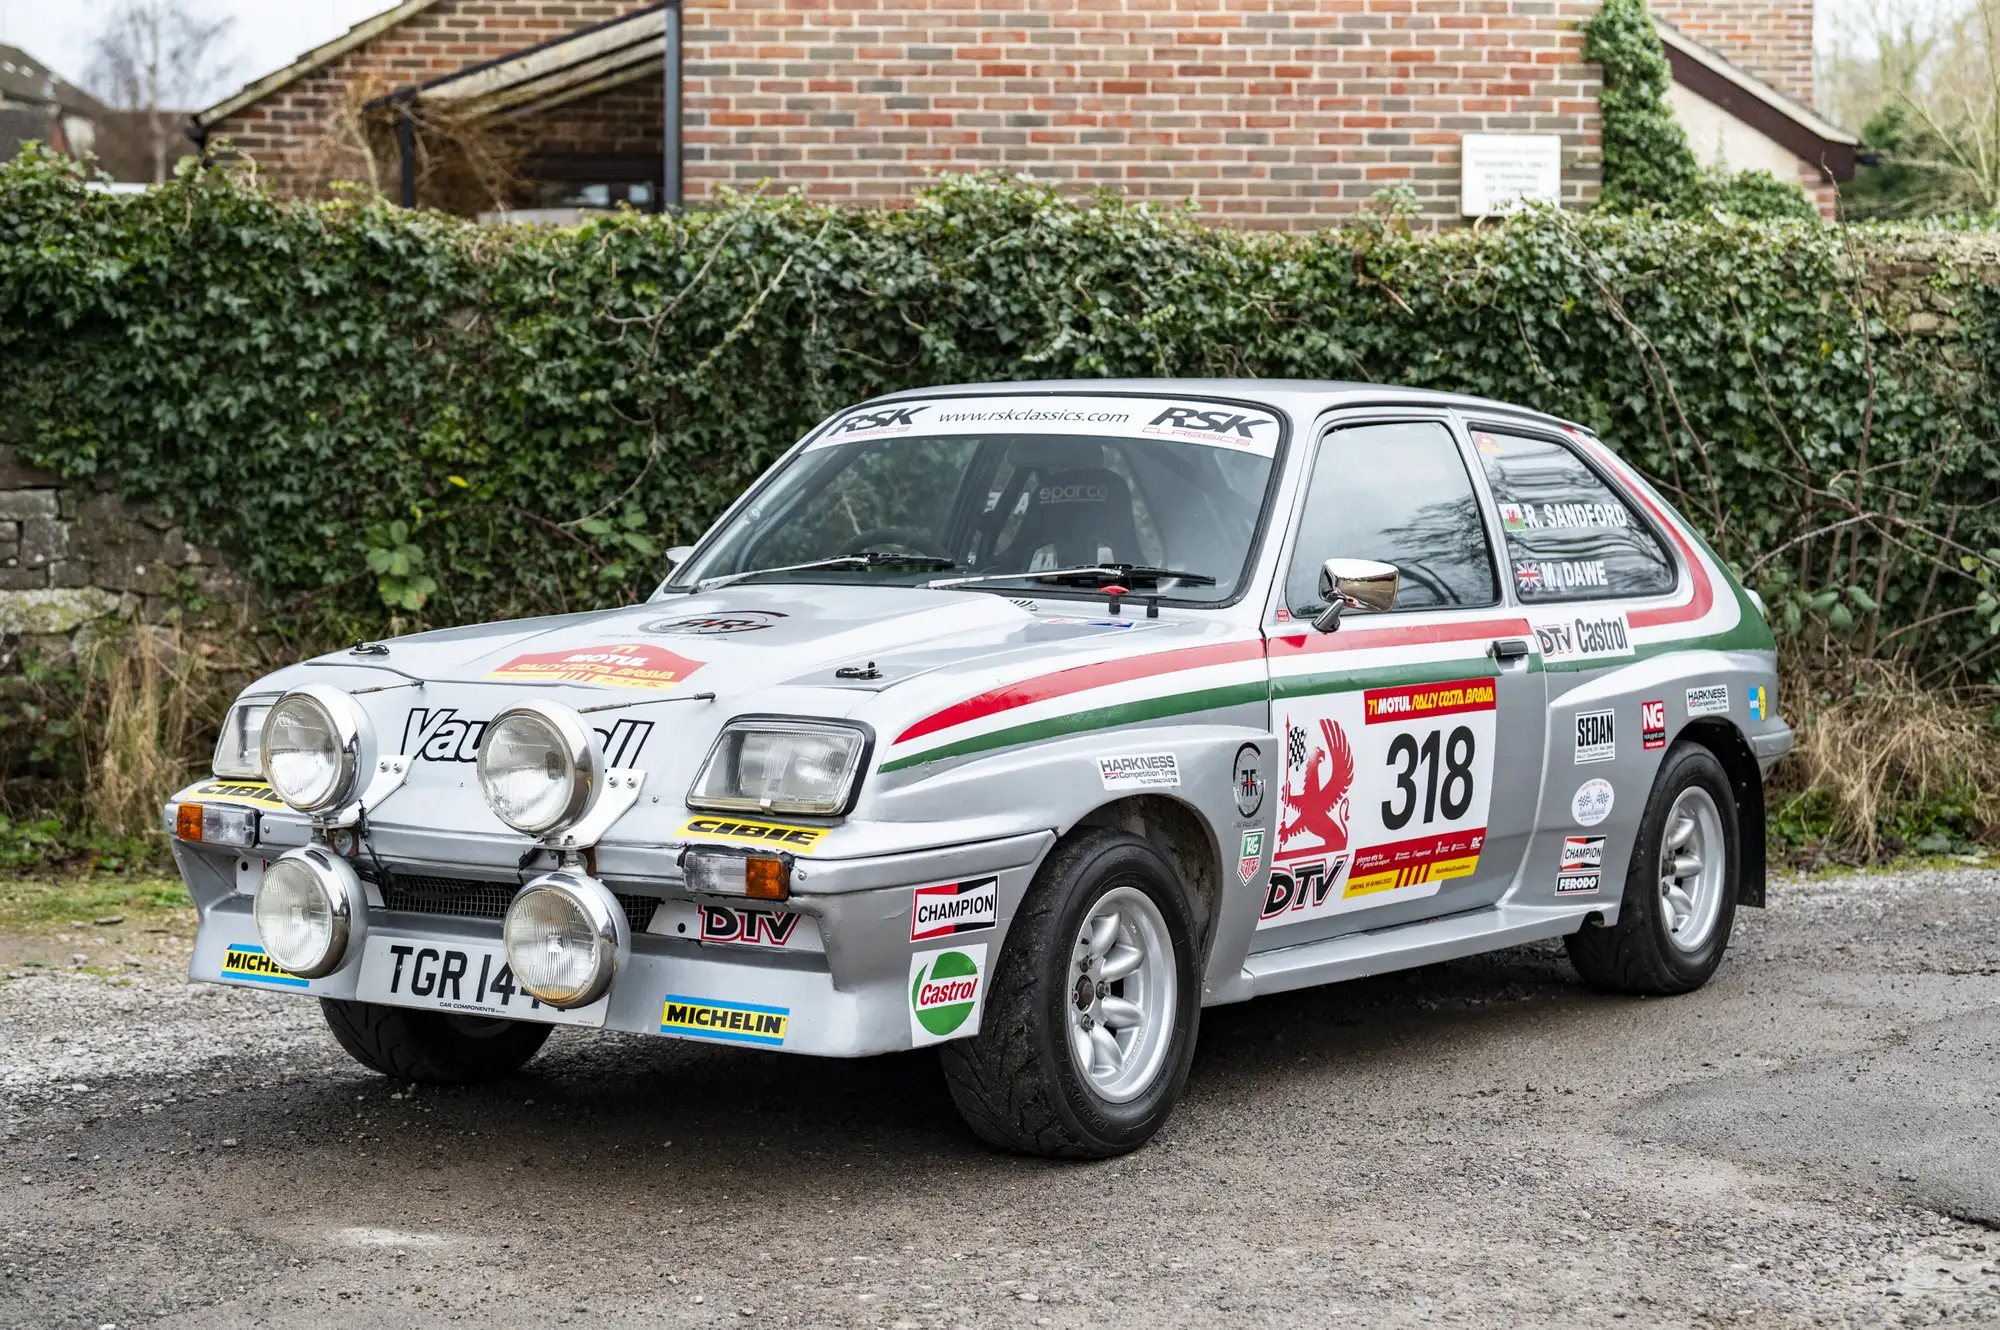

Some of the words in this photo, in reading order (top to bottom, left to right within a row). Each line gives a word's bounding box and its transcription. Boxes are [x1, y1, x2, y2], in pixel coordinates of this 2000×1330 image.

[826, 406, 932, 438] RSK
[939, 408, 1130, 423] www.rskclassics.com
[1147, 406, 1275, 439] RSK
[1142, 427, 1253, 447] CLASSICS
[1039, 484, 1109, 504] sparco
[1525, 503, 1545, 529] R.
[1544, 503, 1628, 529] SANDFORD
[1541, 561, 1561, 587] M.
[1561, 561, 1609, 587] DAWE
[1536, 623, 1574, 658] DTV
[1575, 616, 1629, 653] Castrol
[560, 664, 614, 674] COSTA
[612, 667, 676, 680] BRAVA
[561, 653, 651, 667] MOTUL
[1378, 696, 1411, 715] MOTUL
[1411, 692, 1439, 711] RALLY
[1438, 689, 1464, 707] COSTA
[1465, 686, 1494, 704] BRAVA
[1688, 687, 1727, 701] HARKNESS
[1643, 702, 1665, 730] NG
[1578, 714, 1613, 747] SEDAN
[1099, 755, 1176, 772] HARKNESS
[1118, 769, 1160, 779] Competition
[1160, 768, 1178, 778] Tyres
[1381, 725, 1476, 831] 318
[687, 819, 820, 846] CIBIE
[1246, 835, 1260, 855] TAG
[1564, 847, 1601, 860] CHAMPION
[1262, 855, 1349, 919] DTV
[1558, 877, 1597, 891] FERODO
[918, 894, 995, 923] CHAMPION
[699, 904, 801, 946] DTV
[390, 944, 468, 1000] TGR
[920, 977, 979, 1006] Castrol
[439, 1001, 452, 1009] CAR
[453, 1003, 496, 1013] COMPONENTS
[666, 1004, 783, 1034] MICHELIN
